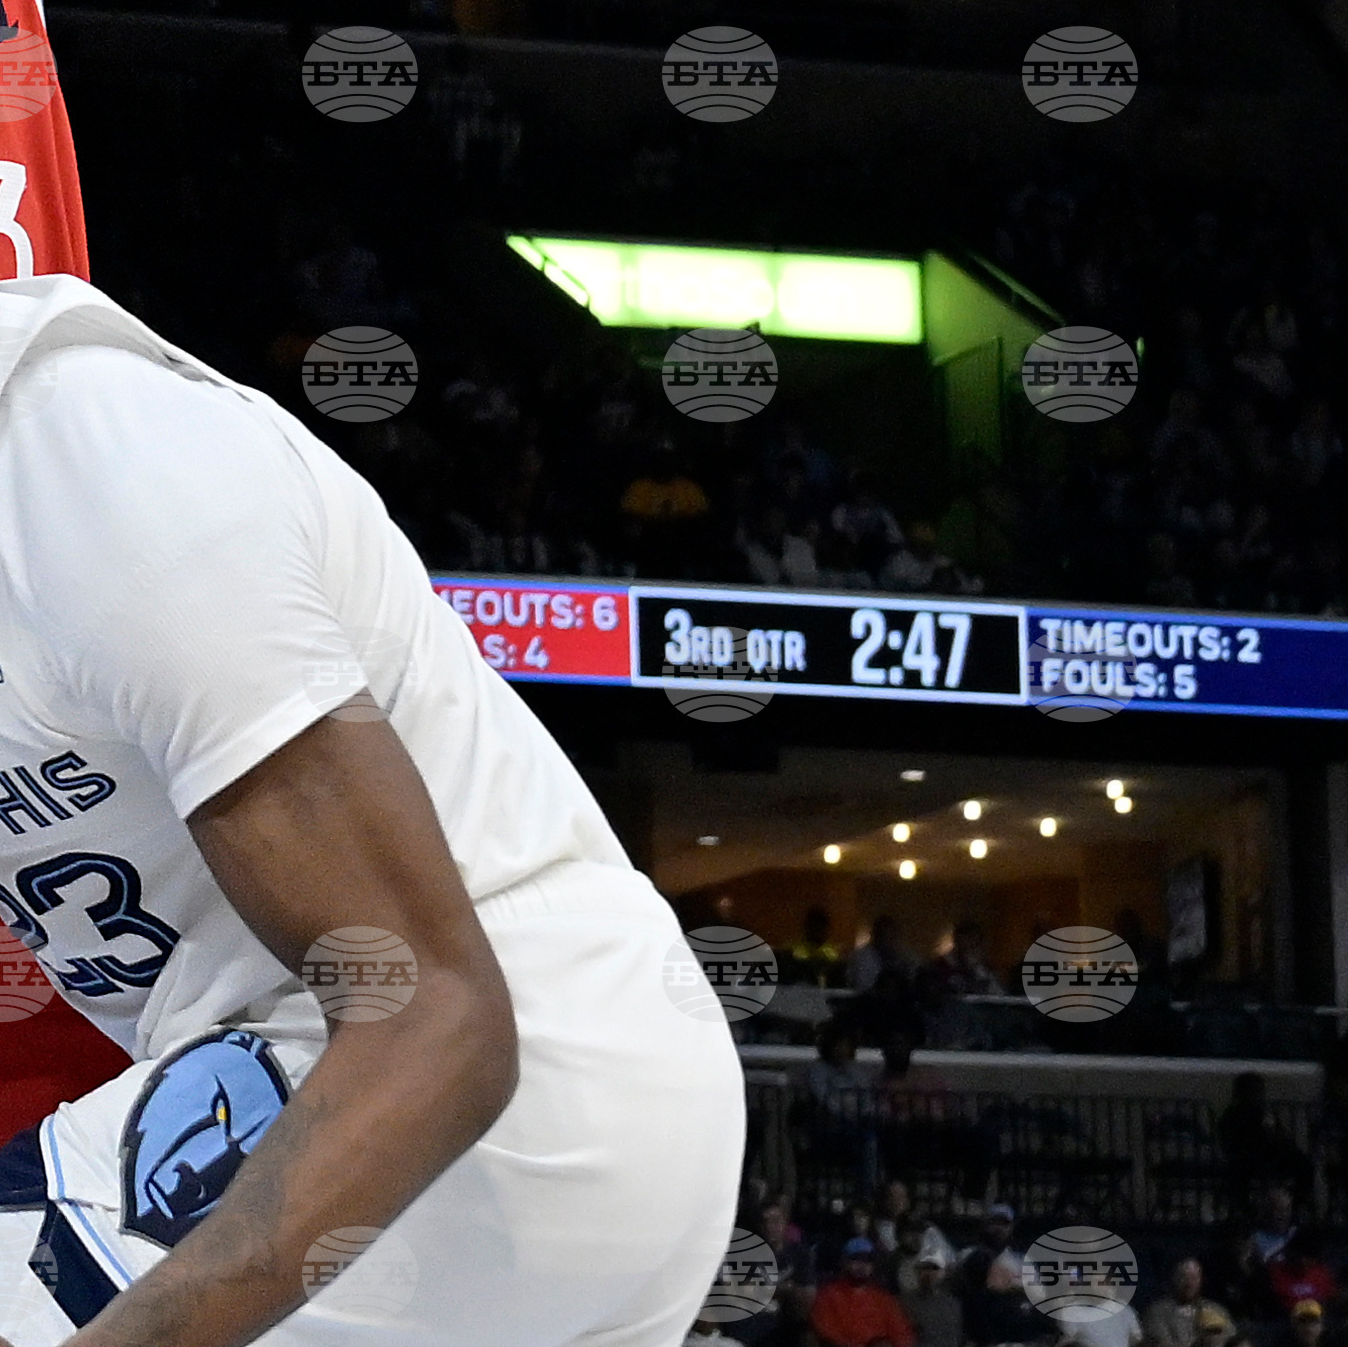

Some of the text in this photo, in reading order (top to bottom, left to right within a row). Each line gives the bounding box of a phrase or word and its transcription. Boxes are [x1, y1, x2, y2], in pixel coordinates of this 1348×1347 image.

[592, 595, 619, 631] 6
[523, 635, 549, 670] 4
[664, 608, 806, 673] 3RD QTR
[851, 608, 971, 688] 2:47
[1040, 618, 1262, 664] TIMEOUTS: 2
[1042, 658, 1168, 698] FOULS:
[1173, 664, 1198, 700] 5
